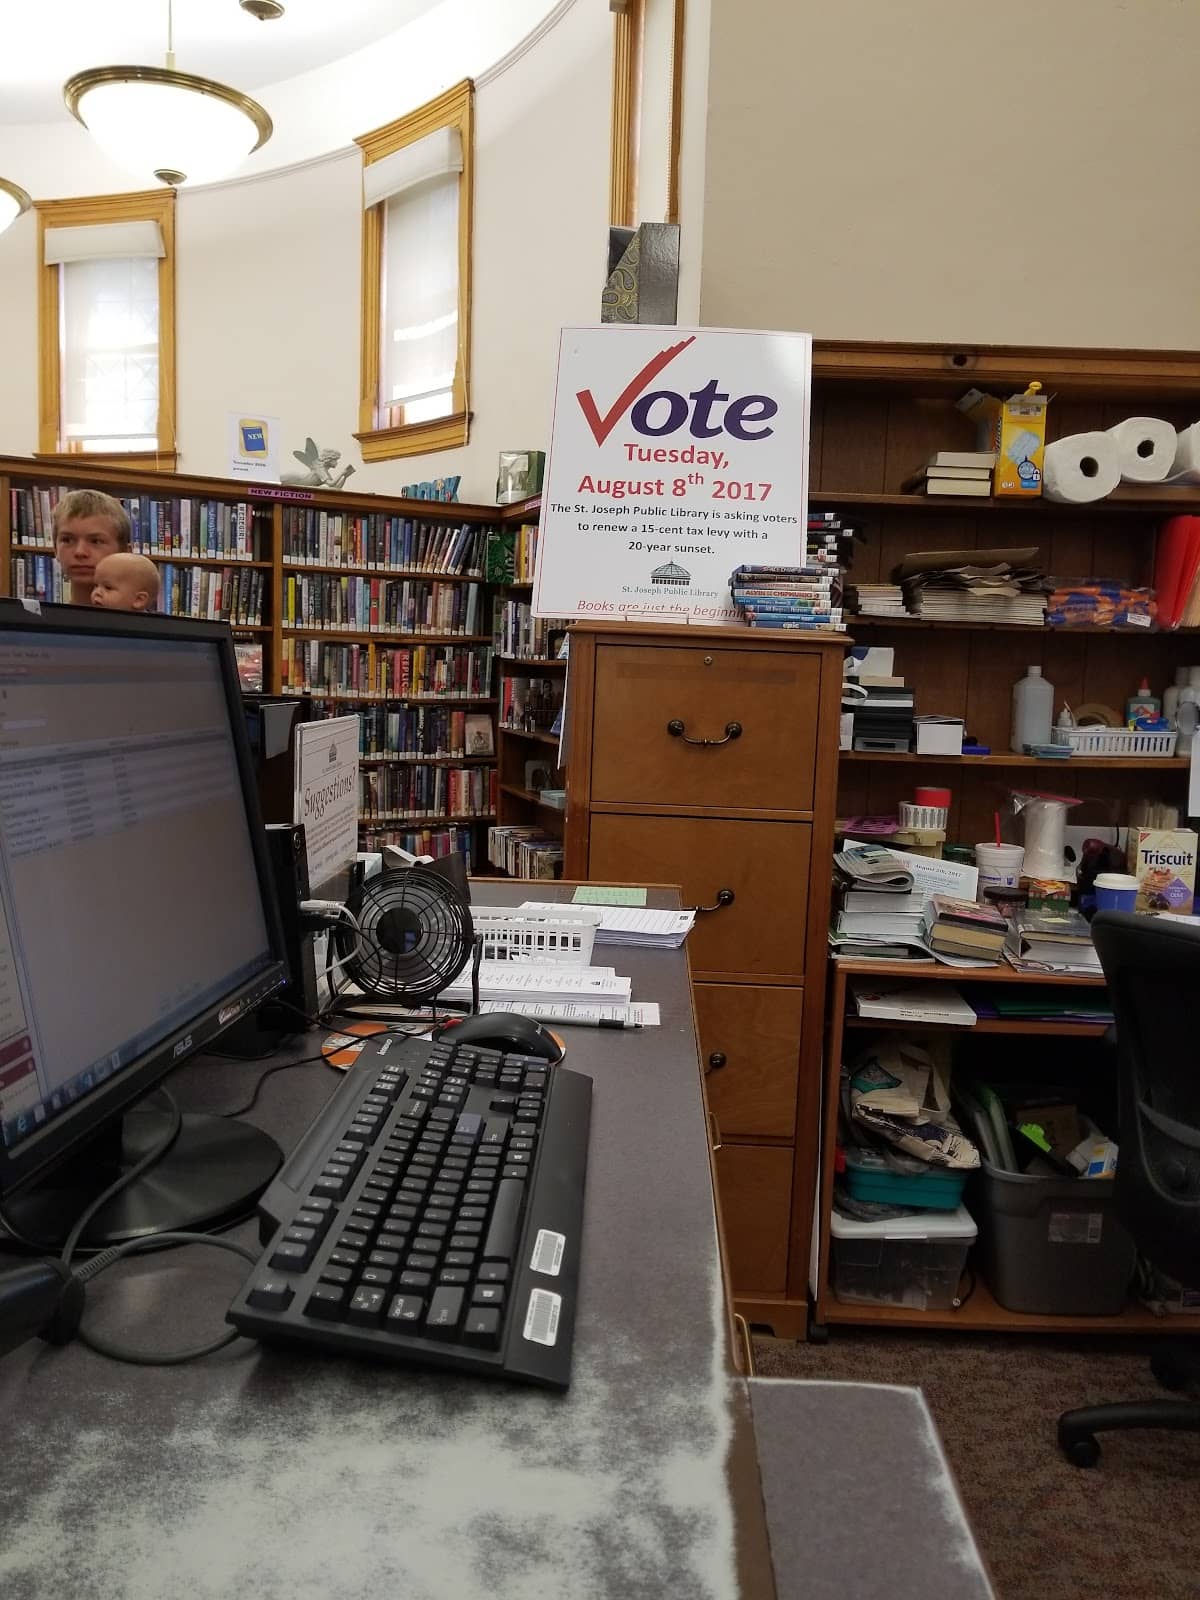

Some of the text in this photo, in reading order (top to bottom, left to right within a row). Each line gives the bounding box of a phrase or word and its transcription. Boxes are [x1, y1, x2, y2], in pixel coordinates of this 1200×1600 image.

[576, 335, 778, 448] Vote
[624, 443, 729, 470] Tuesday,
[274, 490, 312, 499] FICTION
[577, 472, 772, 501] August 8th 2017
[551, 503, 571, 513] The
[574, 504, 589, 513] St.
[592, 505, 630, 516] Joseph
[633, 506, 667, 517] Public
[670, 507, 709, 520] Library
[712, 510, 721, 519] is
[723, 511, 760, 523] asking
[762, 514, 798, 524] voters
[578, 522, 768, 540] to renew a 15-cent tax levy with a
[628, 541, 715, 554] 20-year sunset.
[621, 585, 719, 599] St. Joseph Public Library
[577, 600, 614, 612] Books
[402, 654, 410, 689] REPLIC
[304, 767, 356, 820] Suggestions?
[1141, 849, 1194, 866] Triscuit
